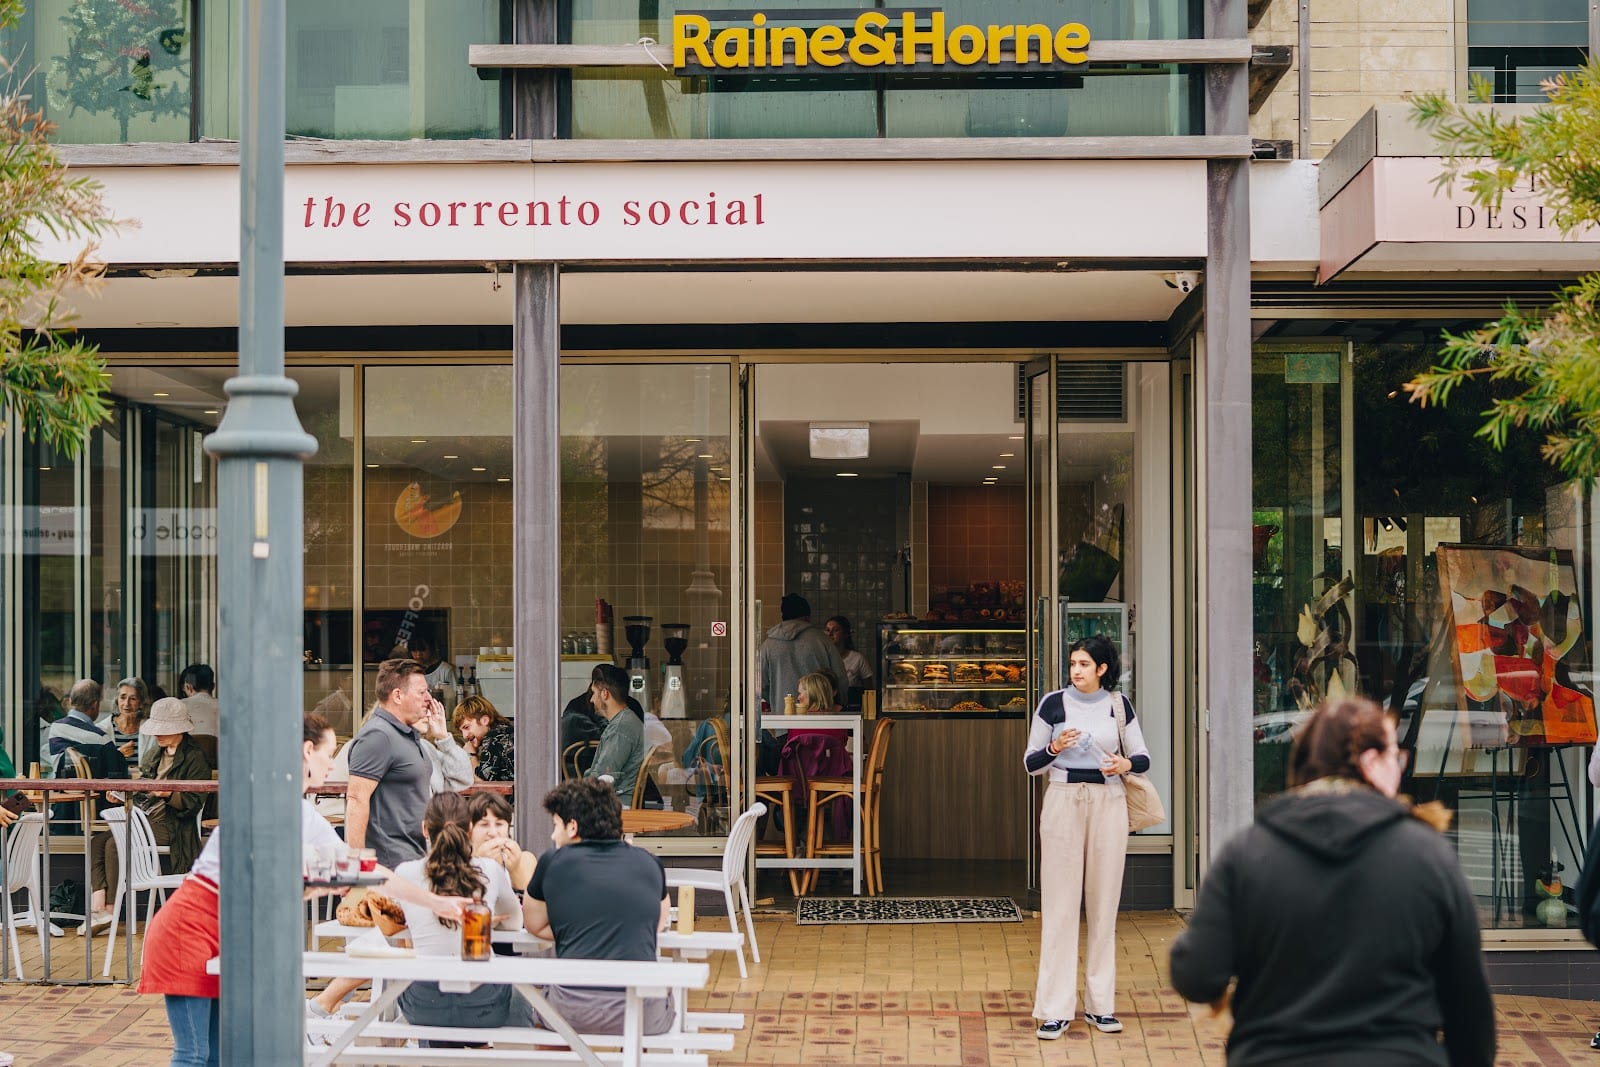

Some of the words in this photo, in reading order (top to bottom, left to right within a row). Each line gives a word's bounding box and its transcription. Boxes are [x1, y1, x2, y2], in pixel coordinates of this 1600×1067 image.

[672, 11, 1092, 69] Raine&Horne
[303, 196, 372, 229] the
[393, 195, 601, 228] sorrento
[622, 191, 766, 226] social
[1455, 205, 1600, 230] DESI
